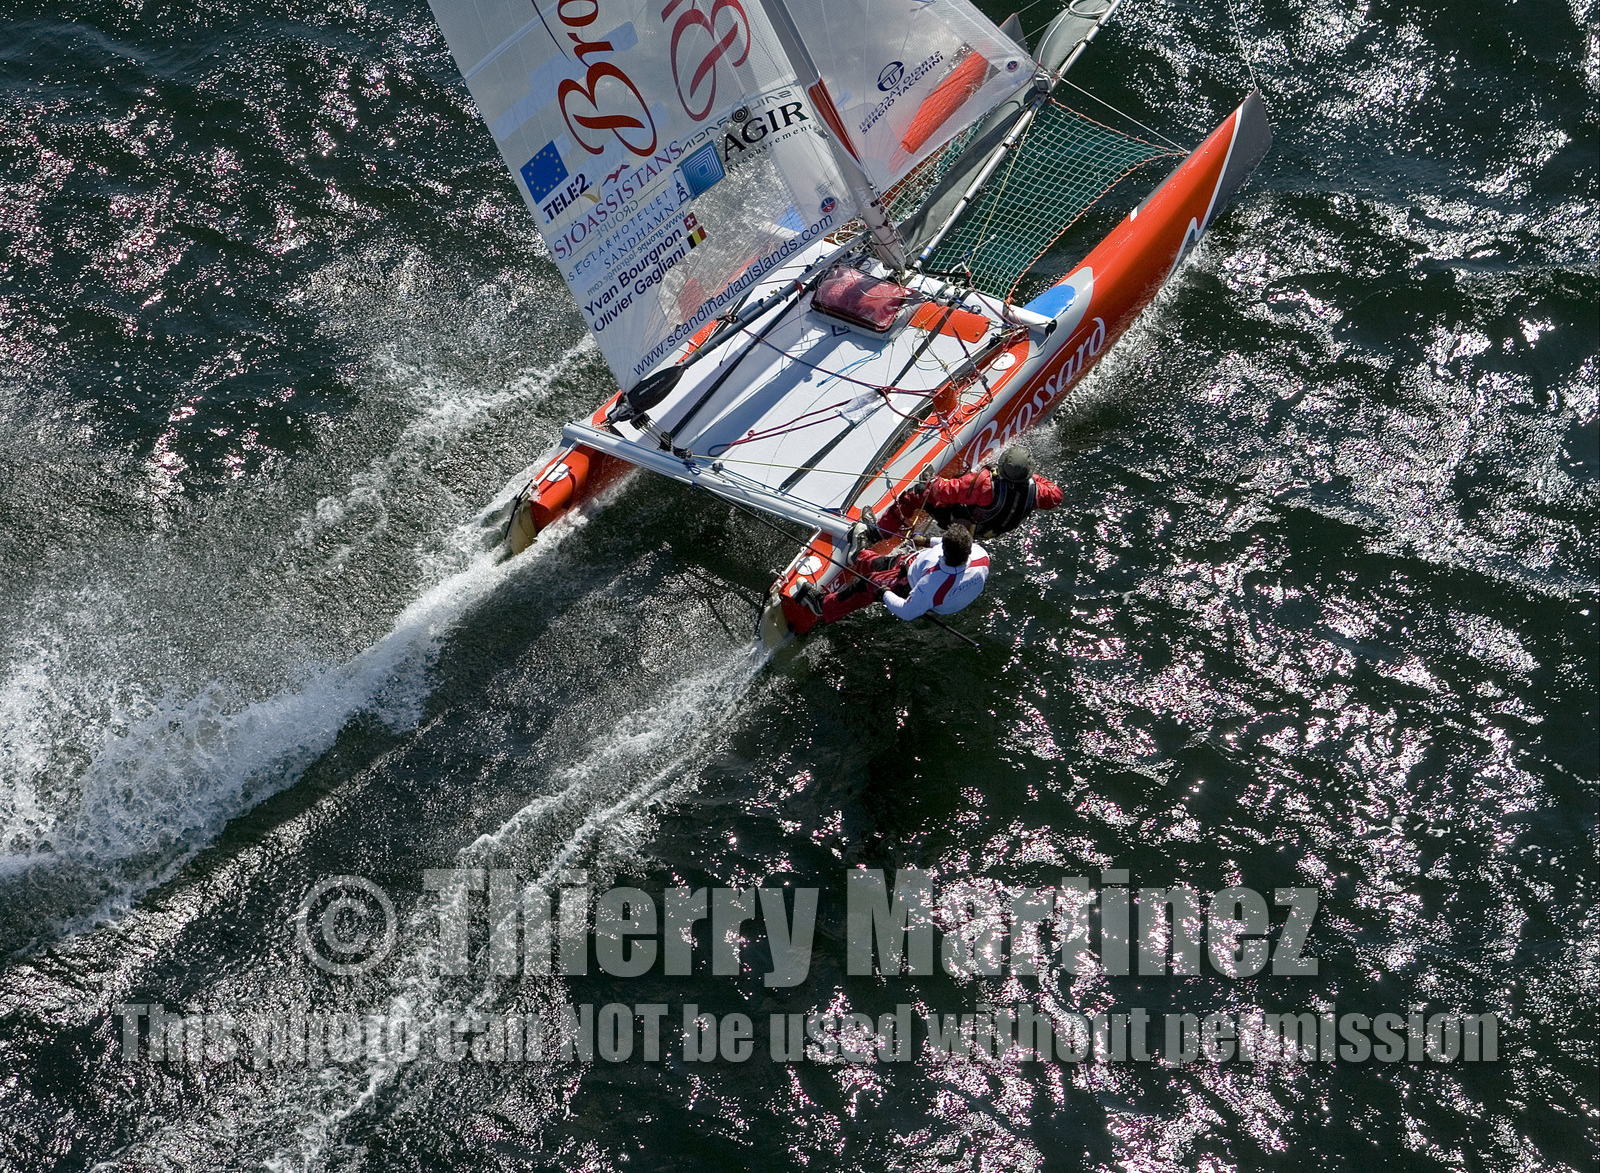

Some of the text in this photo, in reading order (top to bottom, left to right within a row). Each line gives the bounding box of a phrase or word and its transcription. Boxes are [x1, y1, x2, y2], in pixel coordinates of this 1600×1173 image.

[723, 100, 810, 163] AGIR
[861, 55, 945, 136] SERGIO TACCHINI
[727, 123, 813, 174] Recouvrement
[542, 172, 591, 222] TELE2
[553, 139, 683, 260] SJÖASSISTANS
[603, 202, 676, 270] SANDHAMN
[584, 228, 683, 318] Yvan Bourgnon
[593, 243, 687, 333] Olivier Gagliani
[632, 214, 834, 378] www.scandinavianislands.com
[962, 316, 1106, 474] Brossard
